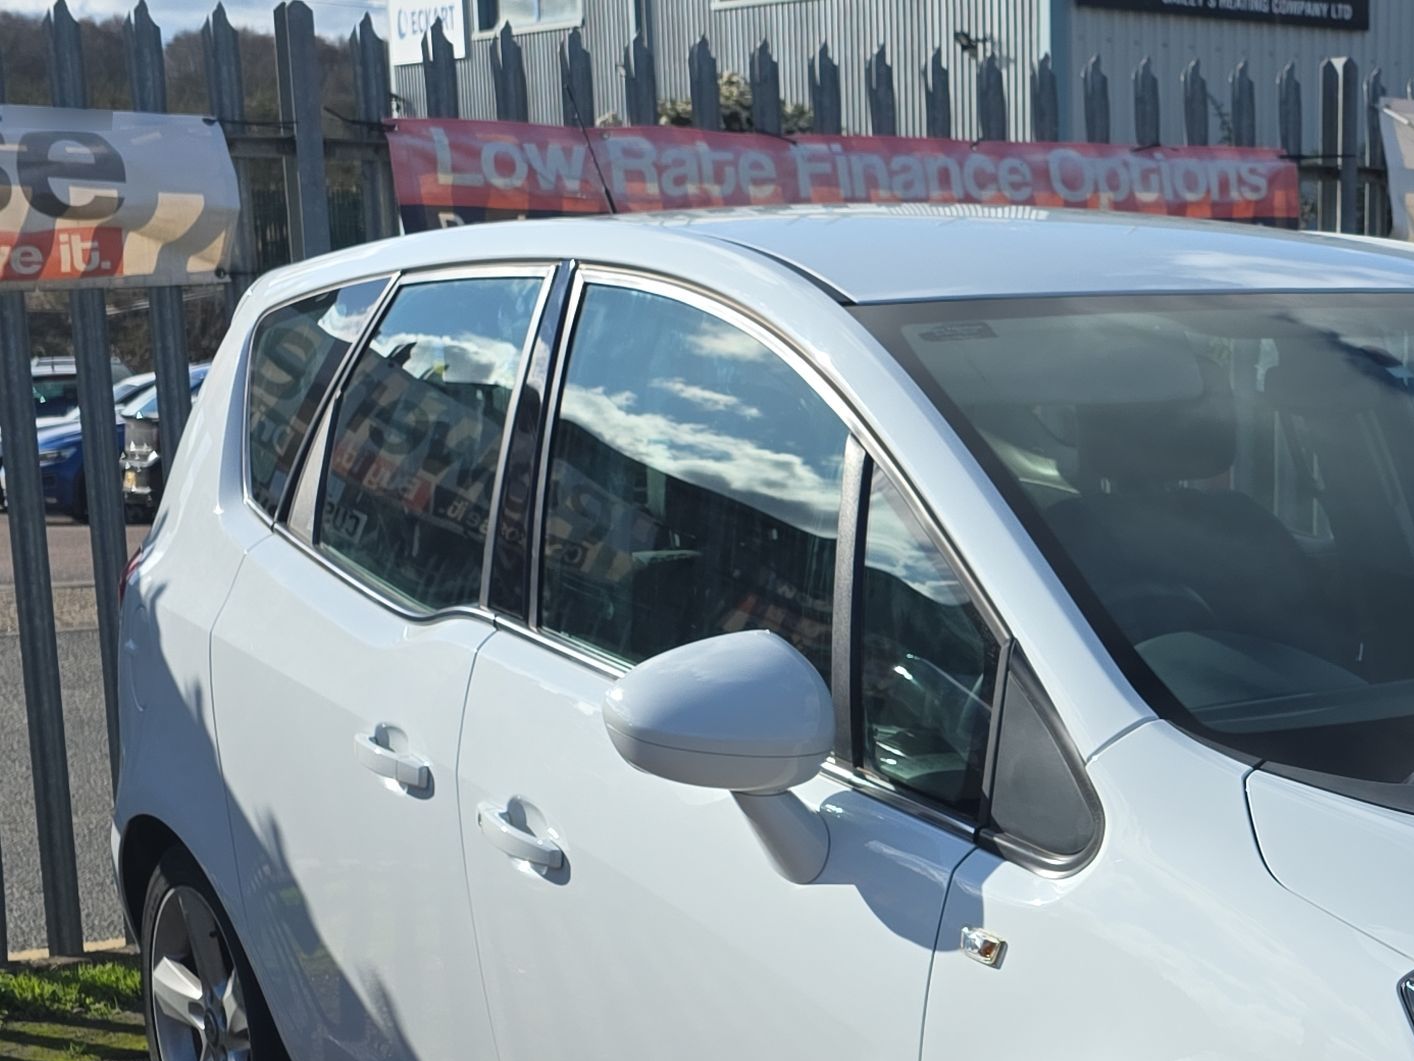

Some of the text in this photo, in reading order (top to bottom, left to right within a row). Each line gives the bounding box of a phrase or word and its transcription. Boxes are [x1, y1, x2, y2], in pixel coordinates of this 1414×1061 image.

[0, 131, 126, 221] e
[430, 127, 1269, 211] Low Rate Finance Options
[0, 233, 111, 275] e it.
